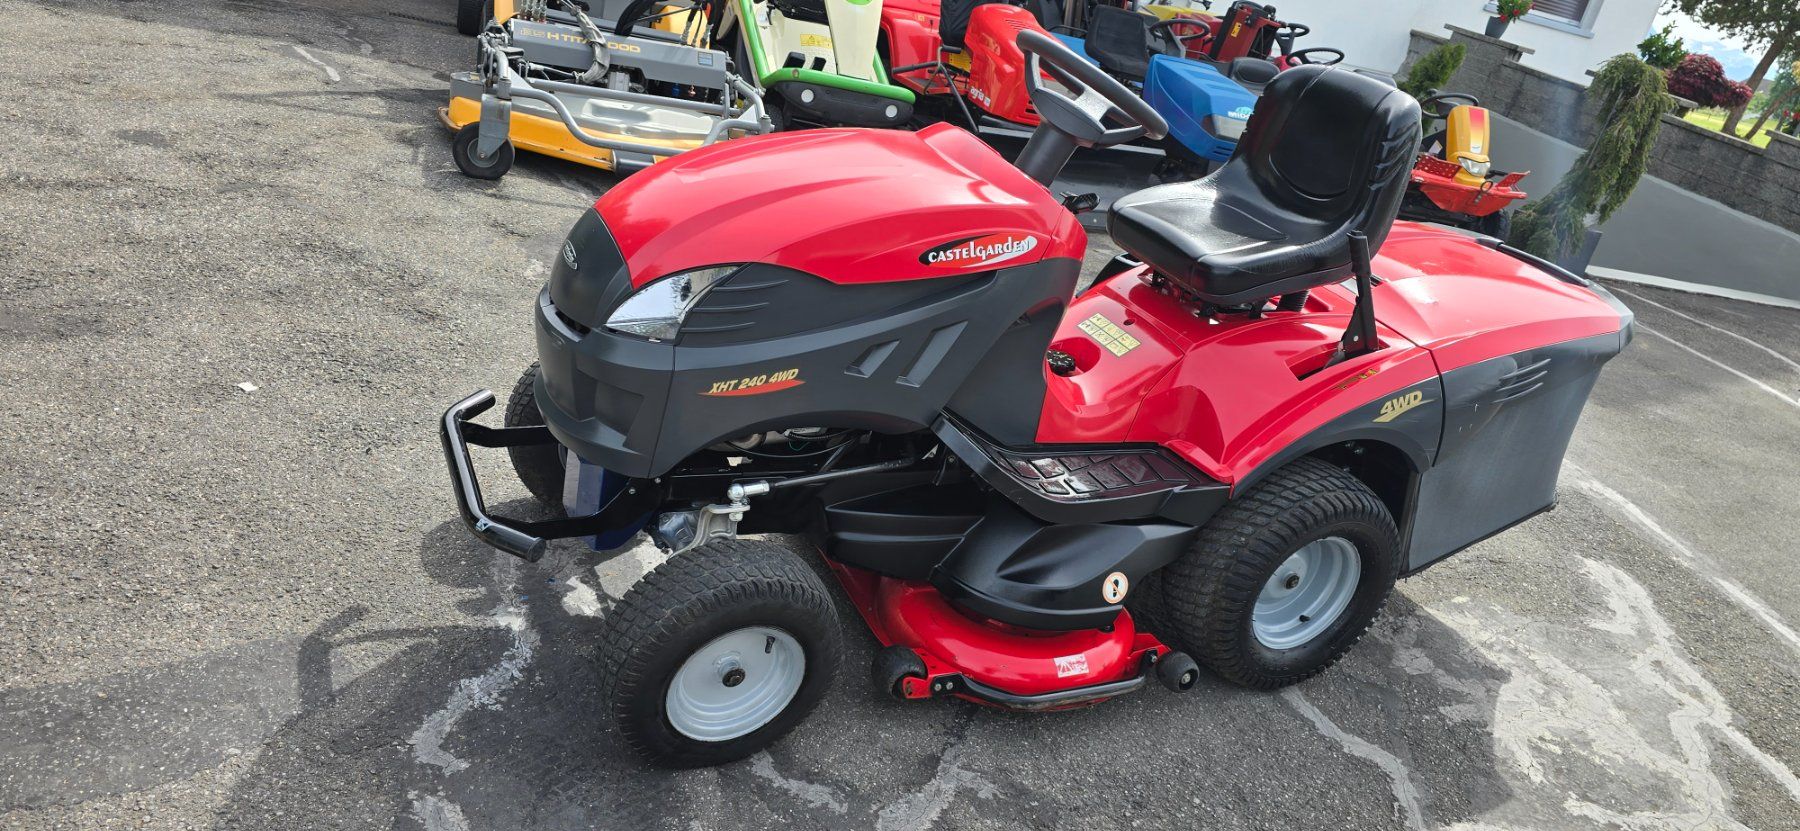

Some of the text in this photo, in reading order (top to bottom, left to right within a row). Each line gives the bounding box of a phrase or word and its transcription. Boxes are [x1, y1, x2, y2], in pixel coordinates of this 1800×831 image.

[708, 368, 799, 394] XHT 240 4WD
[1380, 390, 1423, 415] 4WD
